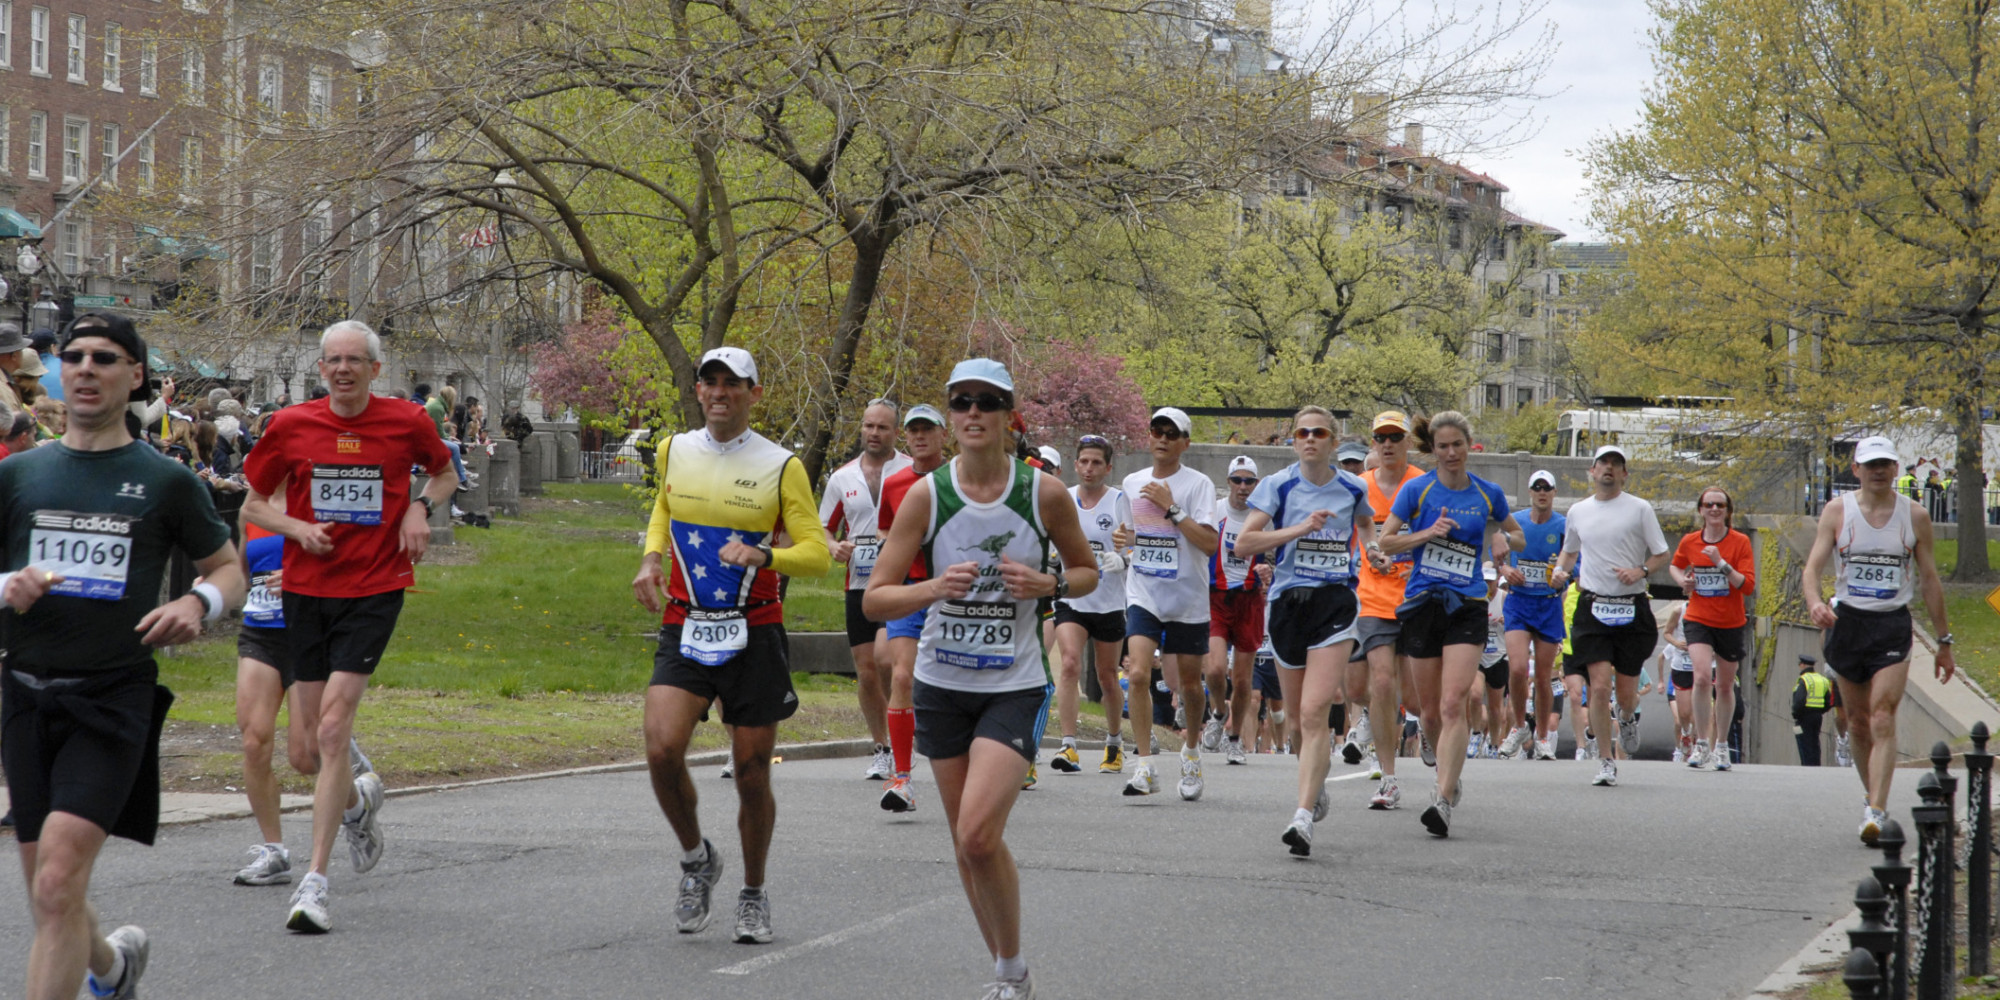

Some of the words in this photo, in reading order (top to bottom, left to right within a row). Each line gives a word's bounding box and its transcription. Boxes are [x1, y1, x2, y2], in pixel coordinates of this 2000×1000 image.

[340, 467, 380, 478] adidas
[320, 483, 373, 502] 8454
[734, 495, 754, 503] TEAM
[724, 499, 762, 510] VENEZUELA
[73, 516, 130, 534] adidas
[1150, 539, 1176, 547] adidas
[1318, 542, 1346, 552] adidas
[1448, 541, 1476, 555] adidas
[37, 537, 127, 567] 11069
[860, 548, 876, 560] 72
[1140, 549, 1172, 563] 8746
[1298, 554, 1348, 567] 11728
[1427, 548, 1472, 572] 11411
[1870, 555, 1900, 566] adidas
[1696, 575, 1727, 586] 10371
[1855, 566, 1894, 582] 2684
[967, 604, 1014, 617] adidas
[692, 624, 739, 643] 6309
[940, 621, 1013, 645] 10789
